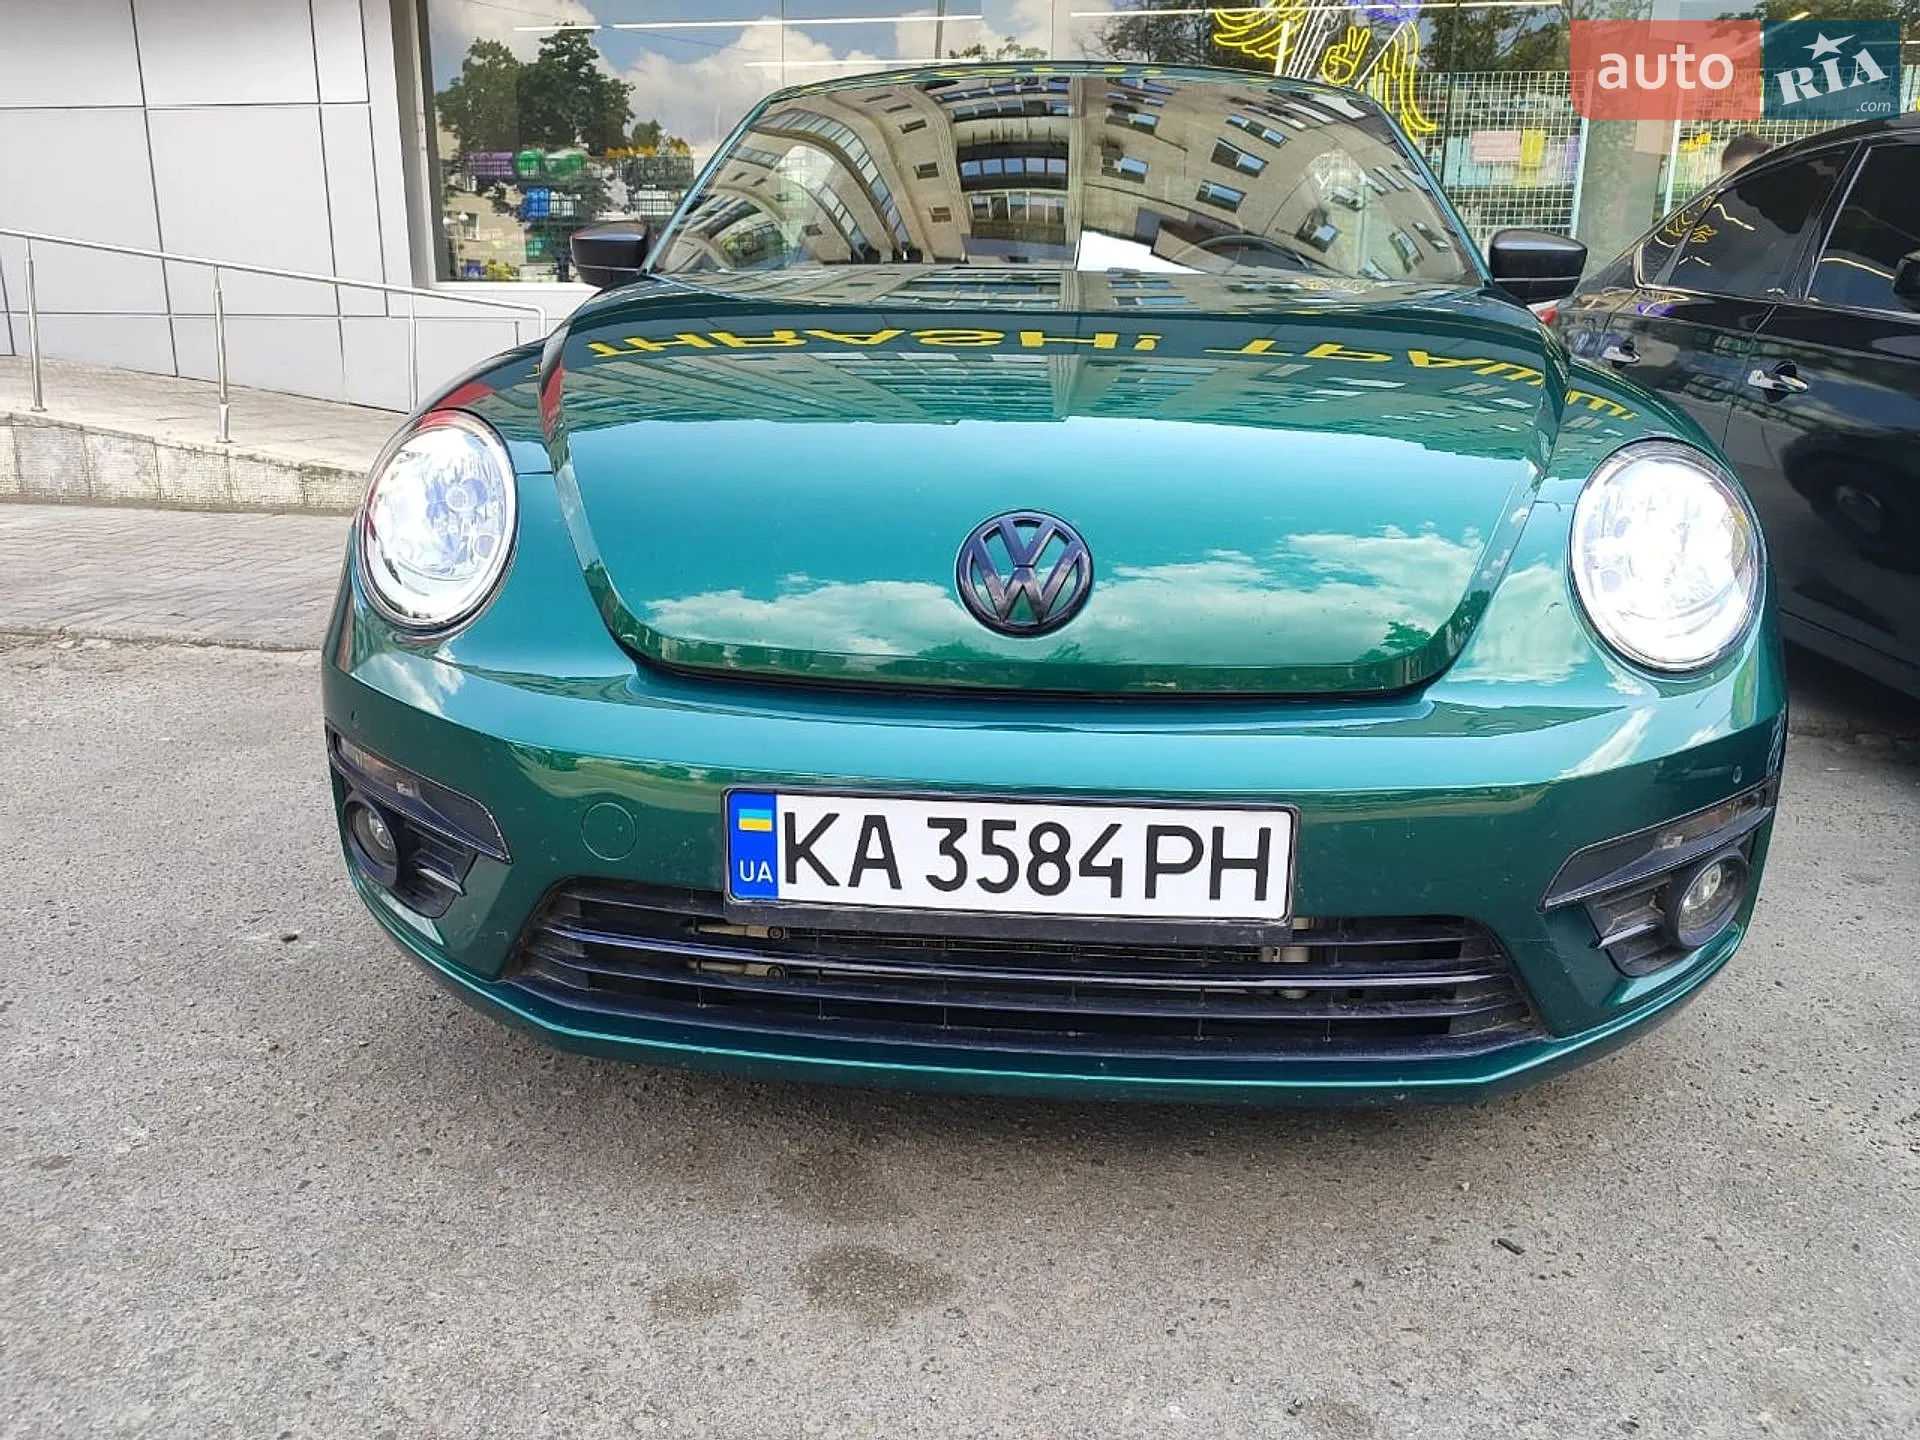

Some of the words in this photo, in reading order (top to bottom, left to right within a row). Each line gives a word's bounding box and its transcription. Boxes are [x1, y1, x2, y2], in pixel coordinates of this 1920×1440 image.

[739, 859, 774, 883] UA
[784, 811, 903, 890] KA
[925, 816, 1123, 899] 3584
[1144, 823, 1273, 902] PH
